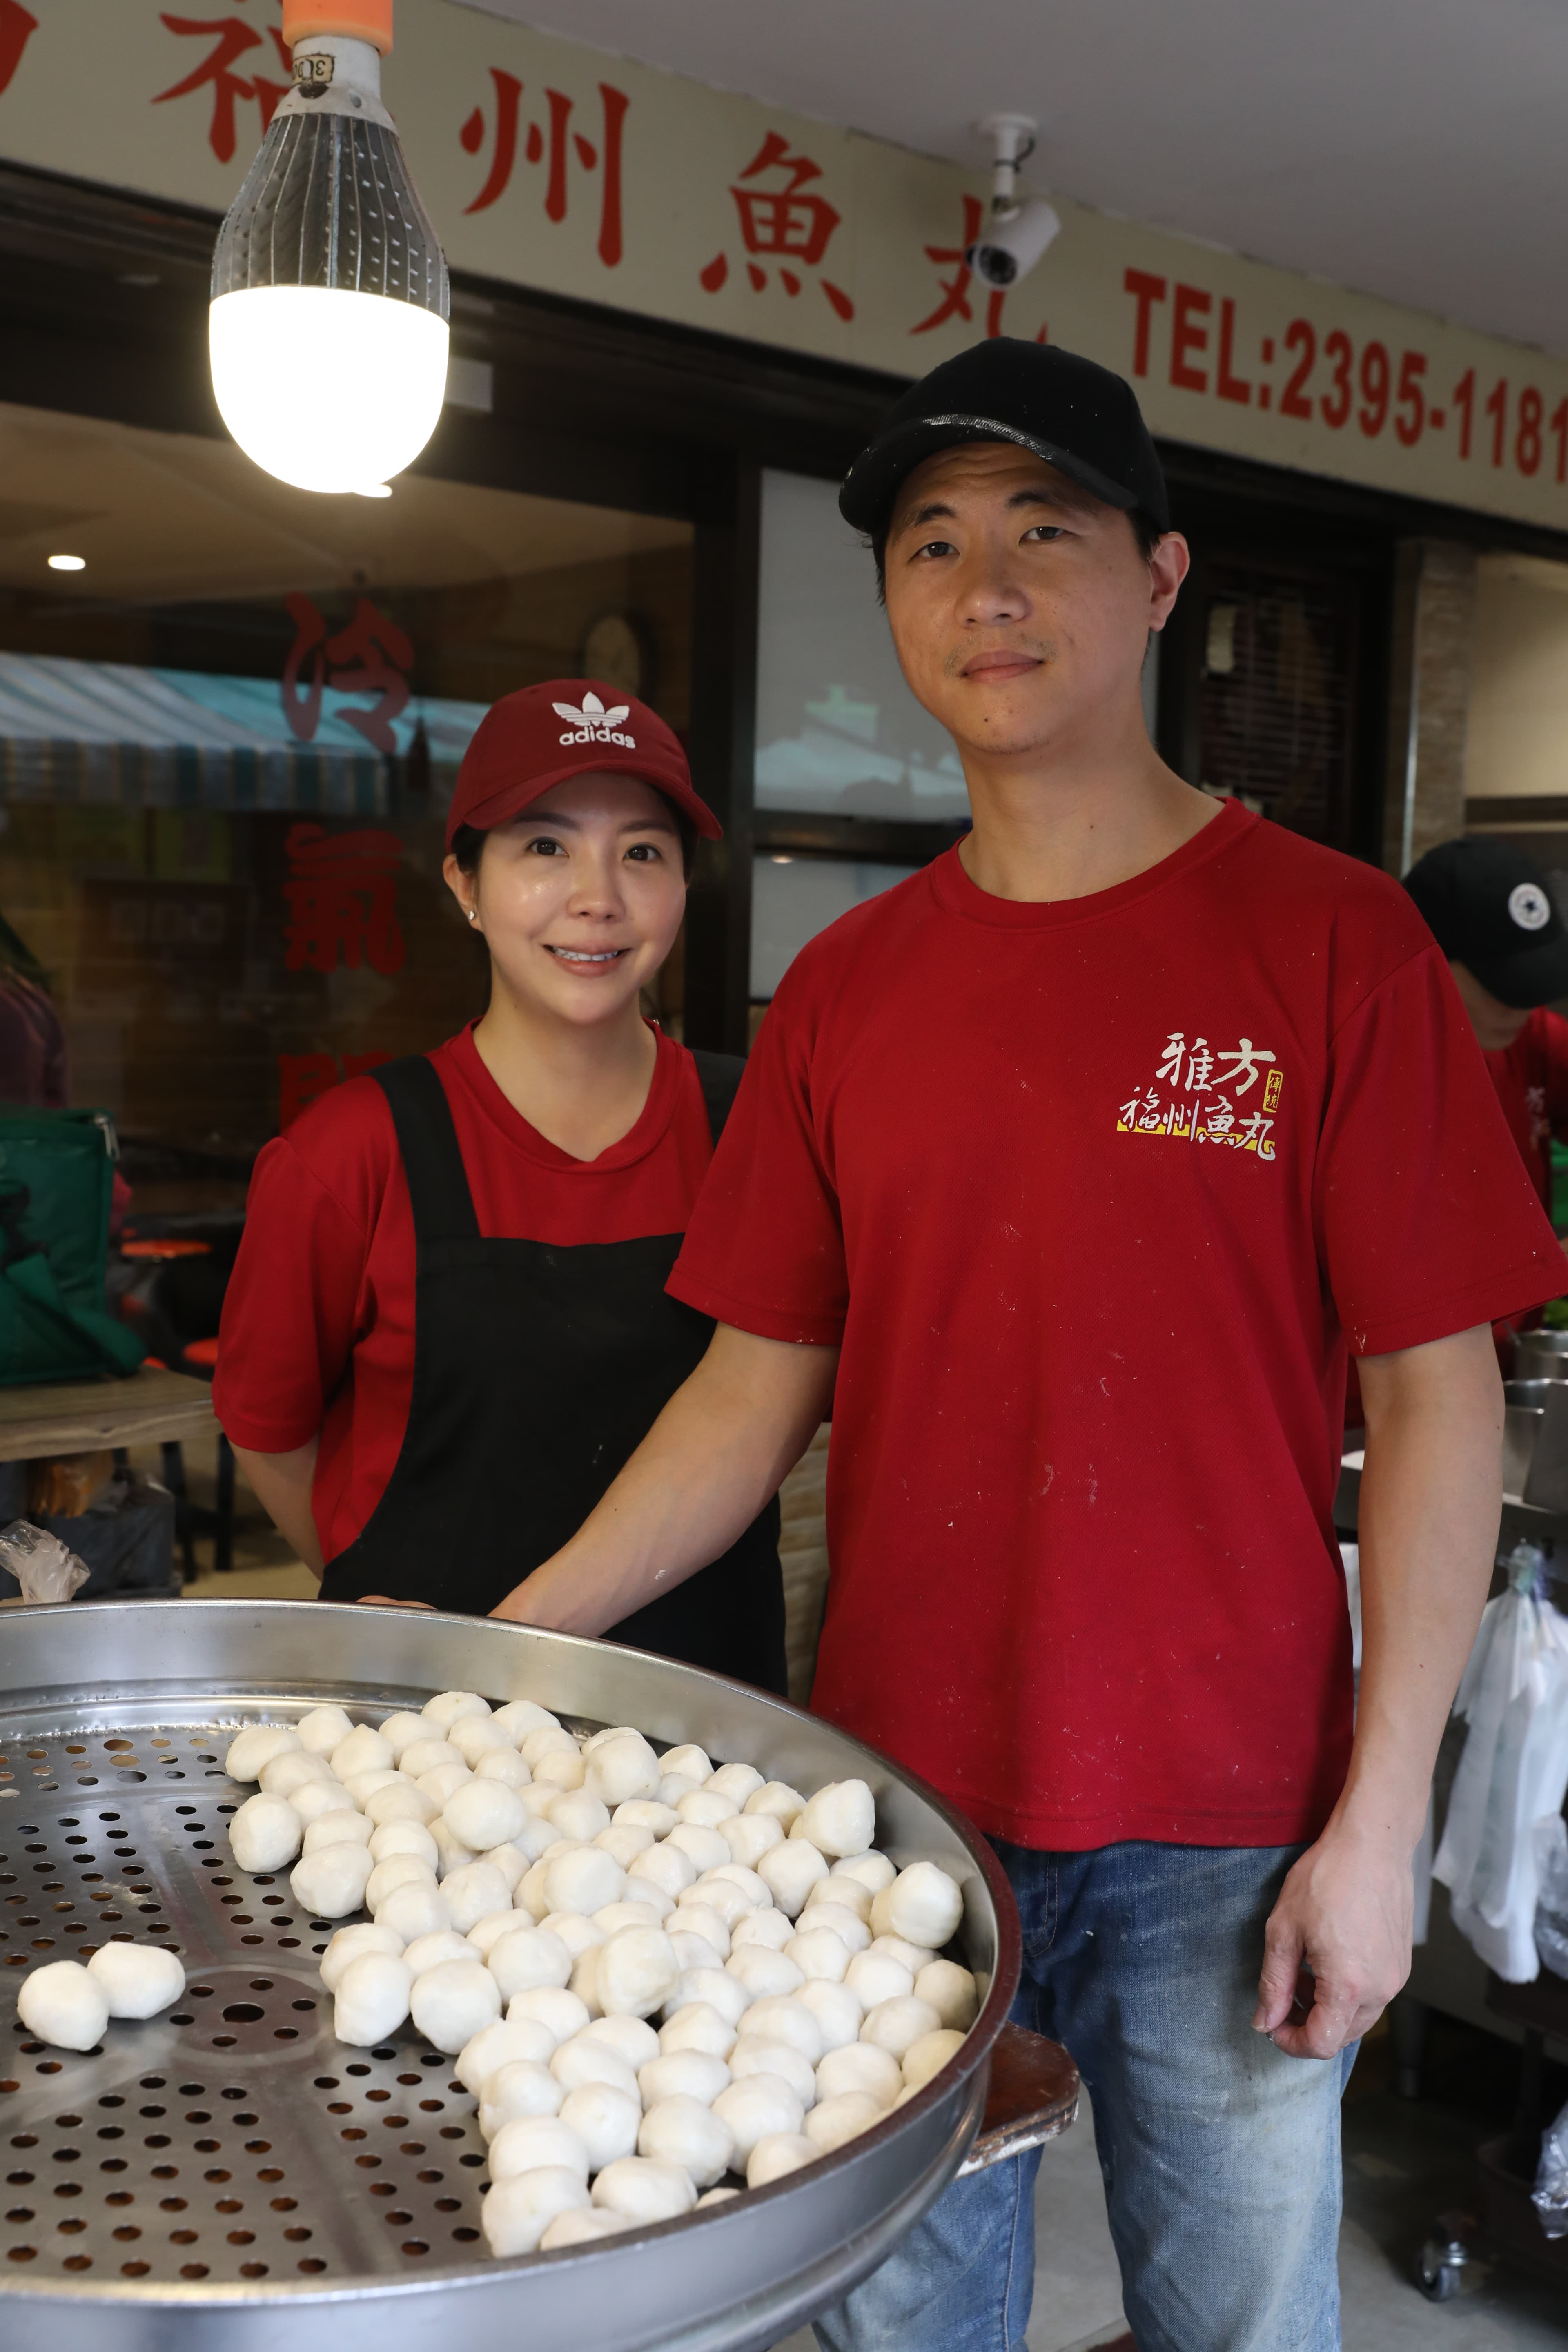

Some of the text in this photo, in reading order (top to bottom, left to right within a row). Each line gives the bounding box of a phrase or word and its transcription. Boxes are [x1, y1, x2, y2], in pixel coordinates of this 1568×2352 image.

[559, 725, 636, 749] adidas
[1155, 1032, 1276, 1096] 雅方
[1265, 1075, 1281, 1109] 傳統
[1119, 1086, 1276, 1161] 福州魚丸
